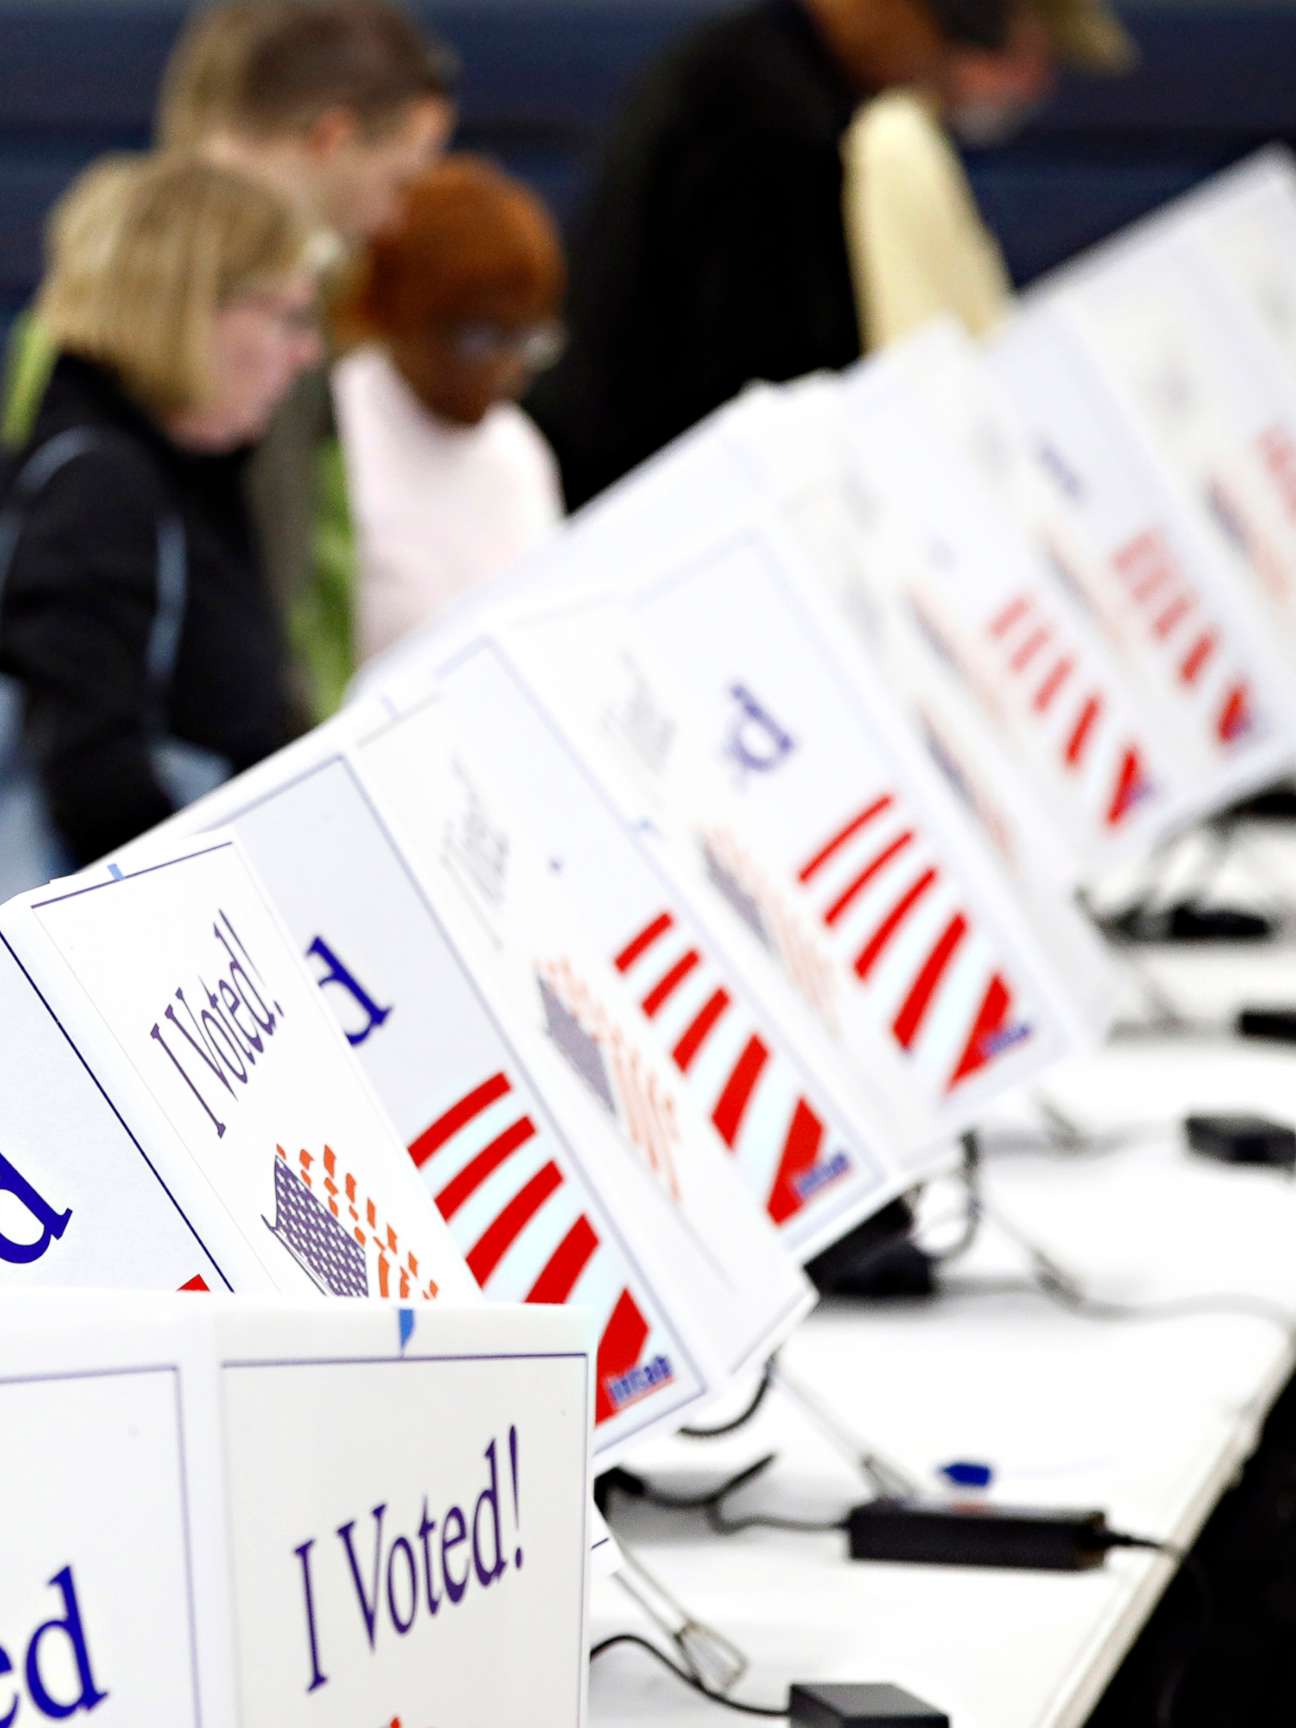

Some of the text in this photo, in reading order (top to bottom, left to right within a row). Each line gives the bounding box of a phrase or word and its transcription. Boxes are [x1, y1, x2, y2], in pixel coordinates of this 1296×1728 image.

[150, 908, 285, 1139] I Voted!
[293, 1423, 524, 1693] I Voted!
